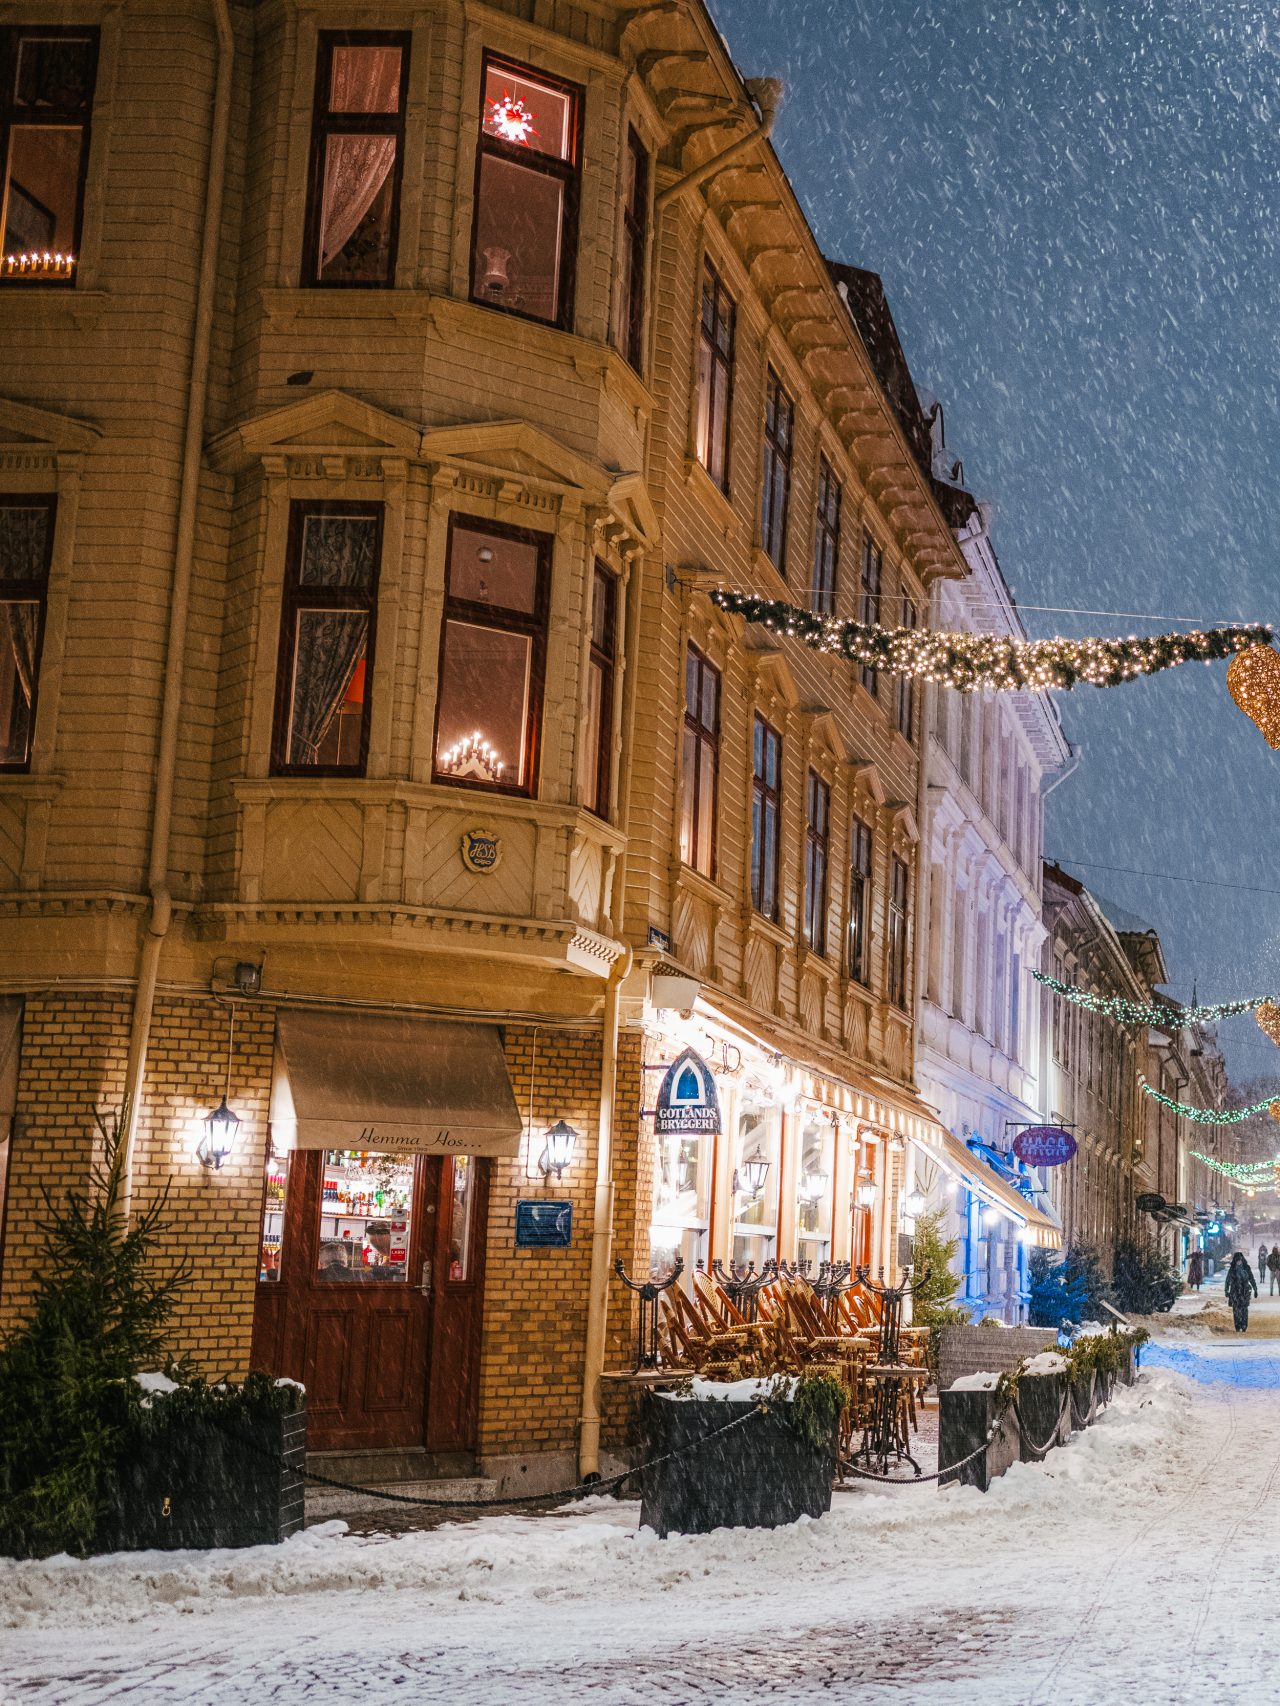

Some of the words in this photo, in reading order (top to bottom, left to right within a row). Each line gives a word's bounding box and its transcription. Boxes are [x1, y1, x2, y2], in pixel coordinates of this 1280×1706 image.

[659, 1107, 717, 1119] GOTLANDS
[660, 1118, 714, 1130] BRYGGERI
[350, 1127, 421, 1146] Hemma
